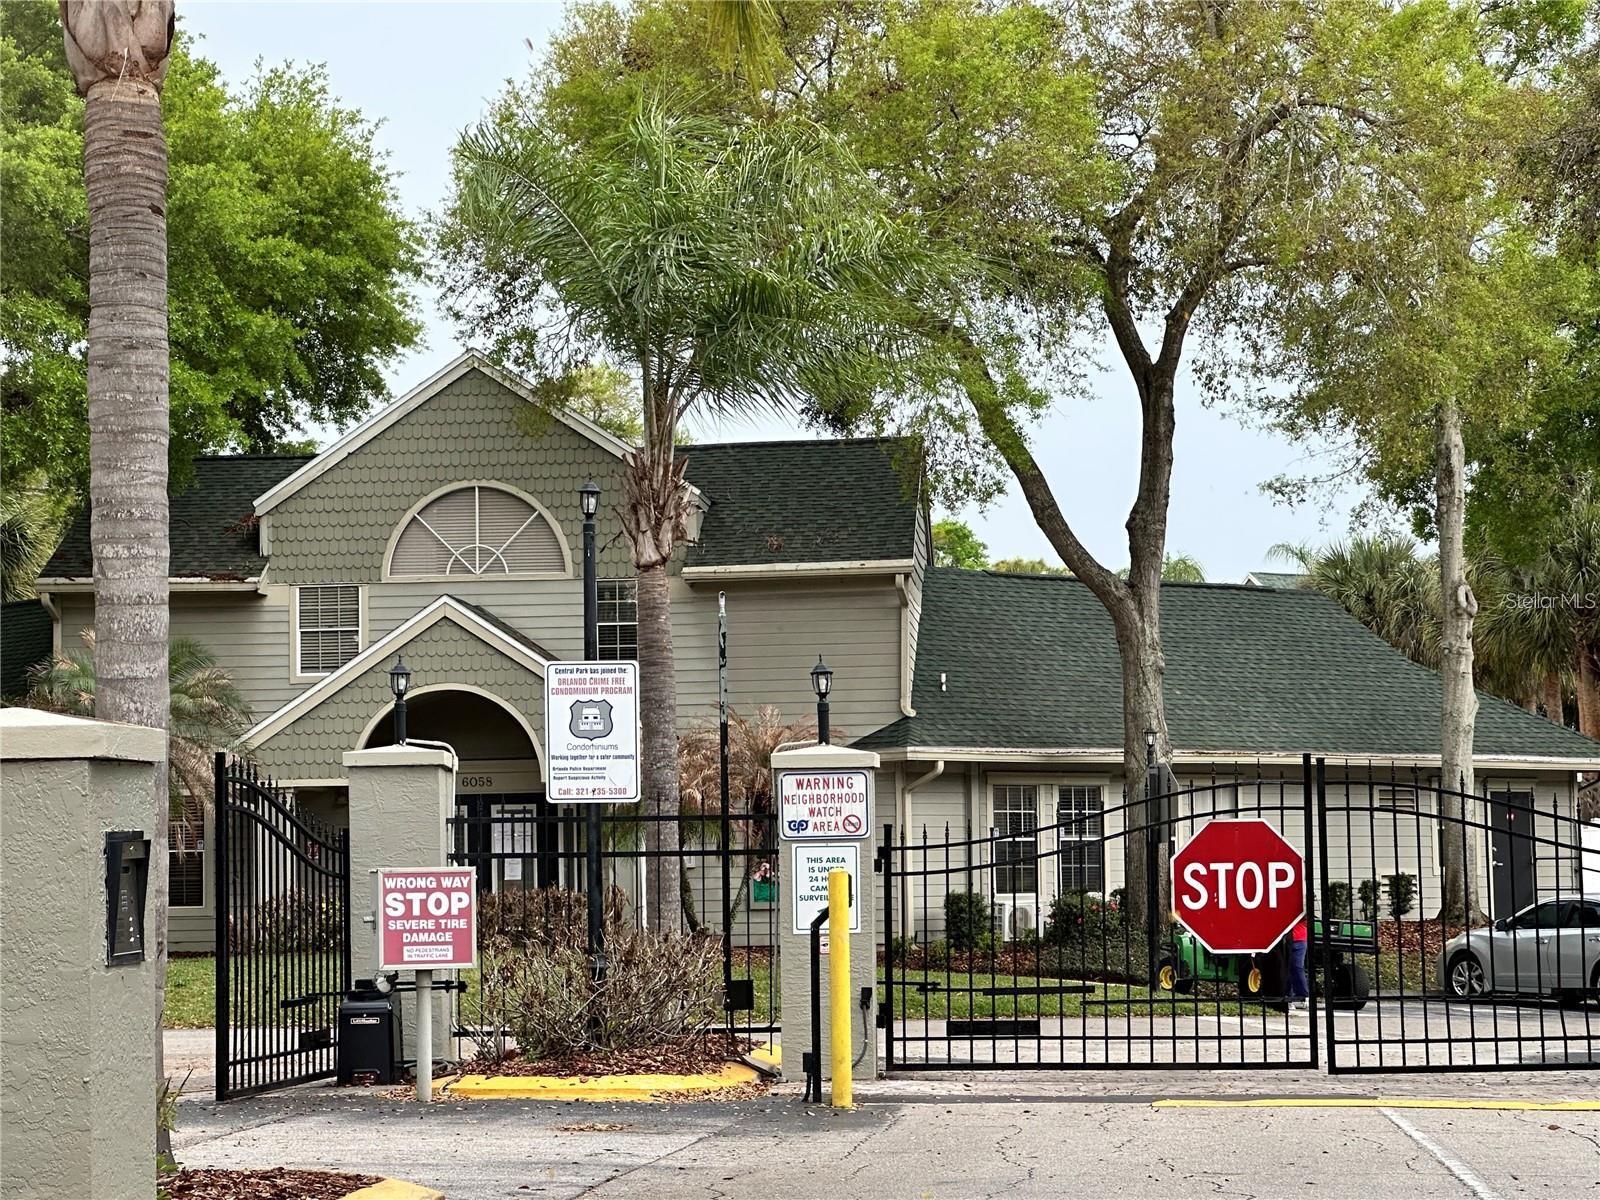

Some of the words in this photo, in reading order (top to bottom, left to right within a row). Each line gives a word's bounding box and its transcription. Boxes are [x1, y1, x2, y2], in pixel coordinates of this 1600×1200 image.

[554, 667, 575, 675] Central
[575, 667, 588, 675] Park
[589, 667, 599, 675] has
[600, 667, 617, 675] joined
[557, 677, 587, 686] ORLANDO
[589, 677, 609, 686] CRIME
[611, 677, 626, 686] FREE
[551, 687, 599, 696] CONDOMINIUM
[600, 686, 633, 695] PROGRAM
[566, 742, 619, 751] Condominiums
[461, 777, 493, 788] 6058
[795, 776, 854, 790] WARNING
[558, 787, 573, 796] Call:
[783, 792, 865, 805] NEIGHBORHOOD
[808, 806, 842, 817] WATCH
[812, 820, 840, 832] AREA
[806, 856, 824, 864] THIS
[825, 856, 847, 864] AREA
[384, 876, 437, 889] WRONG
[440, 876, 470, 889] WAY
[808, 875, 819, 883] 24
[1181, 861, 1296, 910] STOP
[385, 891, 470, 917] STOP
[388, 919, 436, 930] SEVERE
[438, 918, 468, 929] TIRE
[402, 931, 453, 943] DAMAGE
